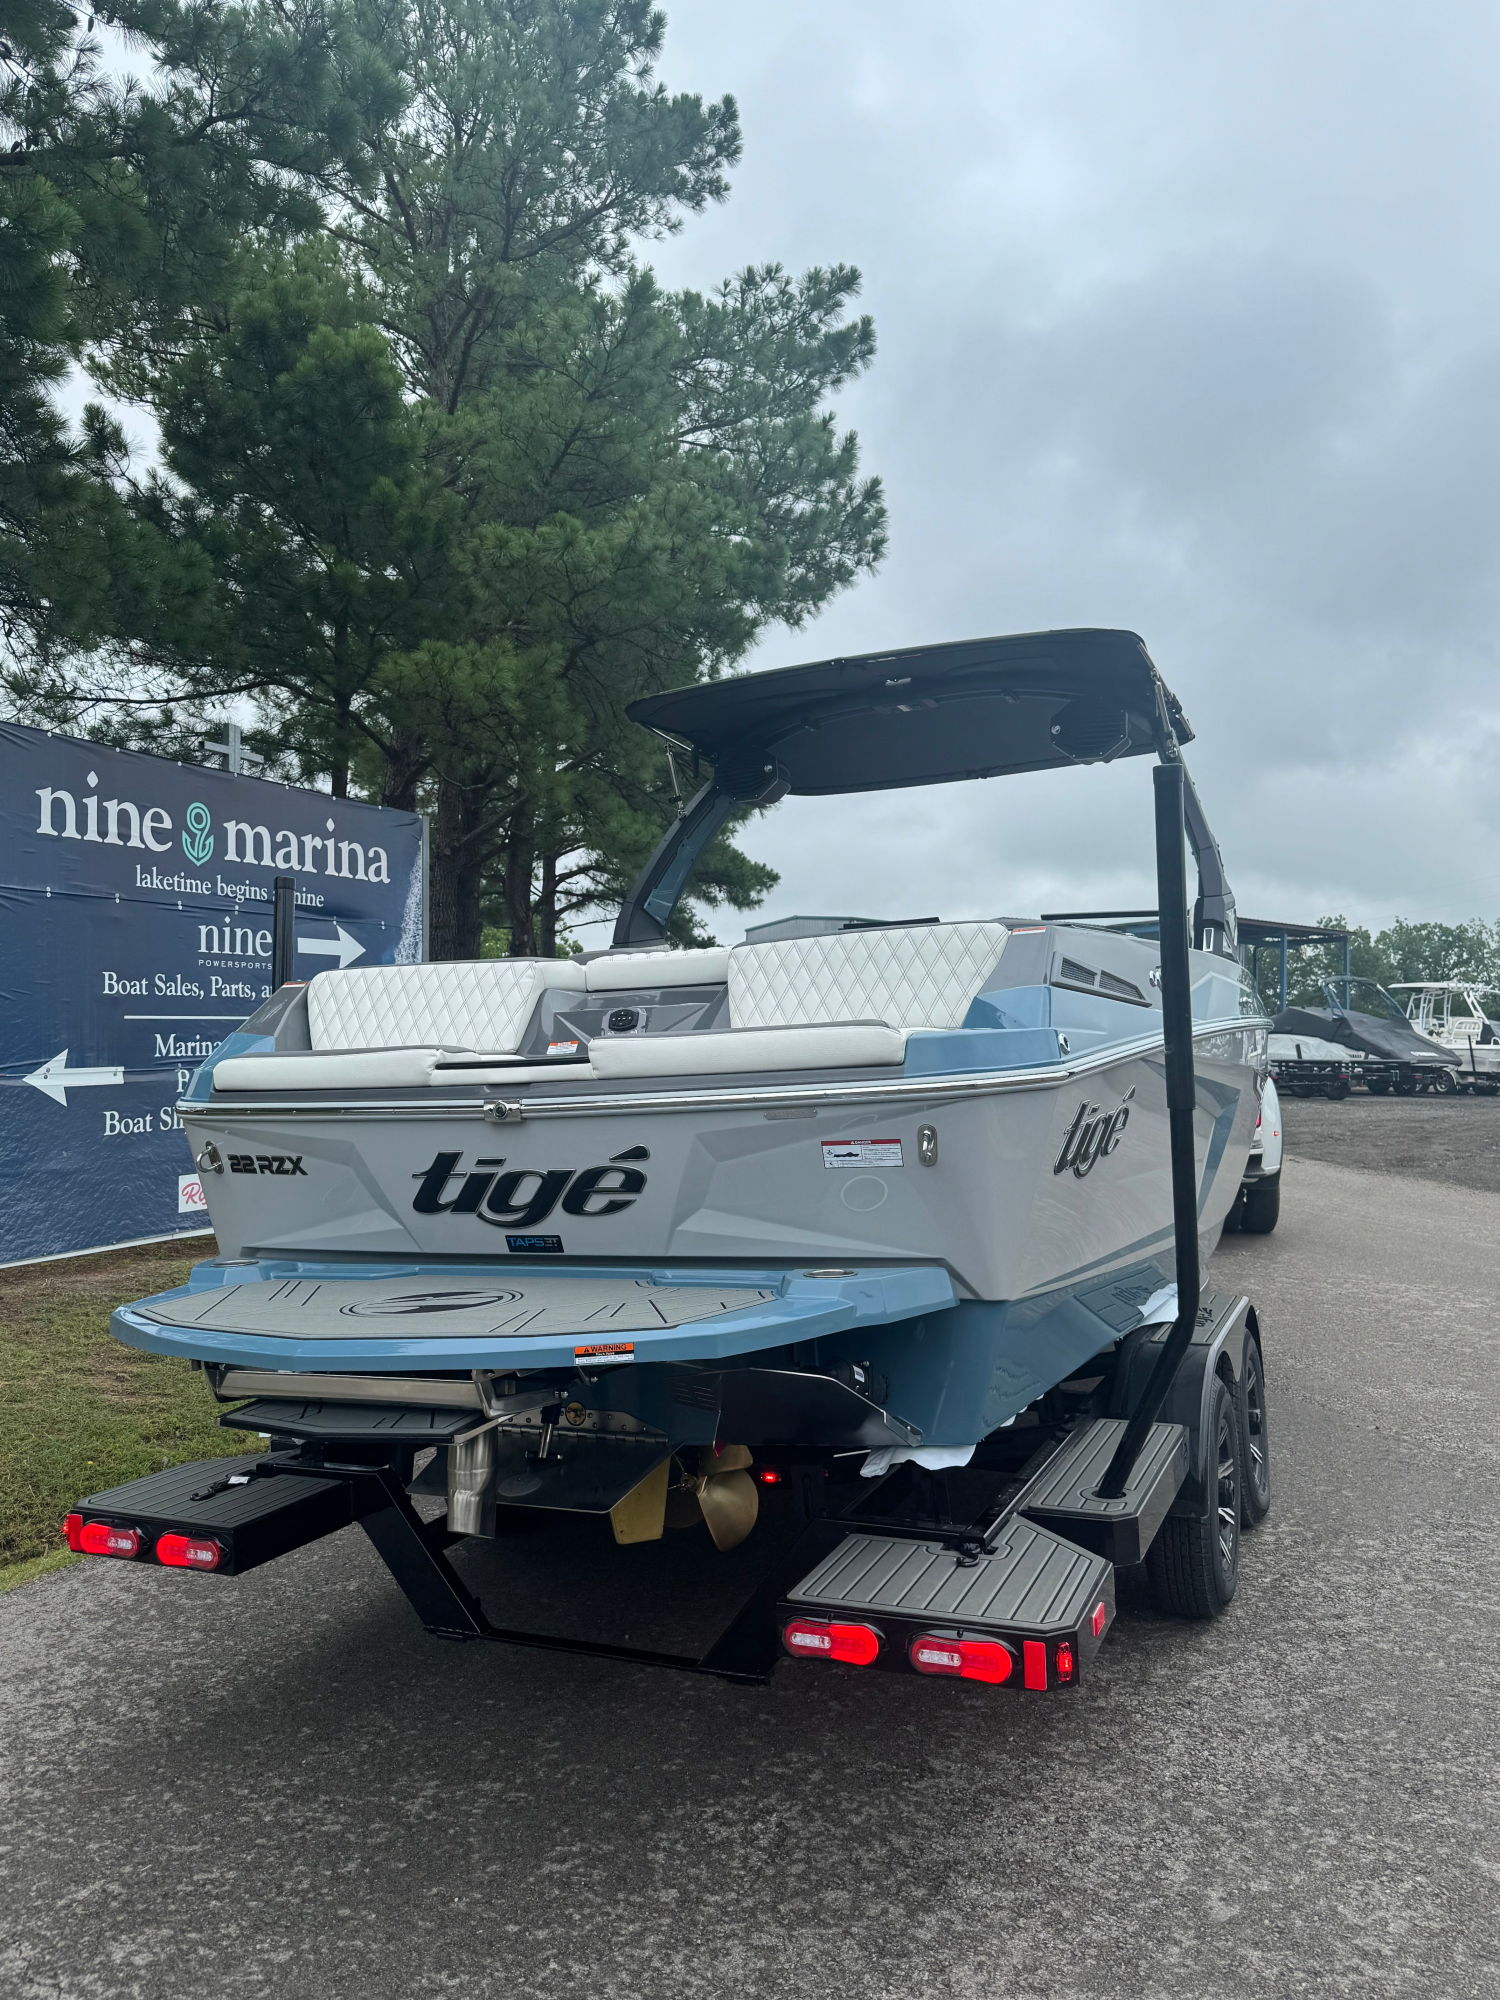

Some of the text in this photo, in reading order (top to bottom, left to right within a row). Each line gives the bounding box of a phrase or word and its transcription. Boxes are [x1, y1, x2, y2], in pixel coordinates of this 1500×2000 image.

[35, 770, 391, 884] nine marina
[135, 864, 212, 895] laketime
[216, 875, 268, 902] begins
[197, 915, 272, 957] nine
[198, 959, 273, 970] POWERSPORTS
[102, 971, 149, 995] Boat
[154, 973, 205, 1000] Sales,
[210, 975, 256, 1001] Parts,
[103, 1110, 153, 1136] Boat
[1053, 1085, 1136, 1179] tigé
[411, 1143, 651, 1229] tigé
[591, 1344, 627, 1352] WARNING
